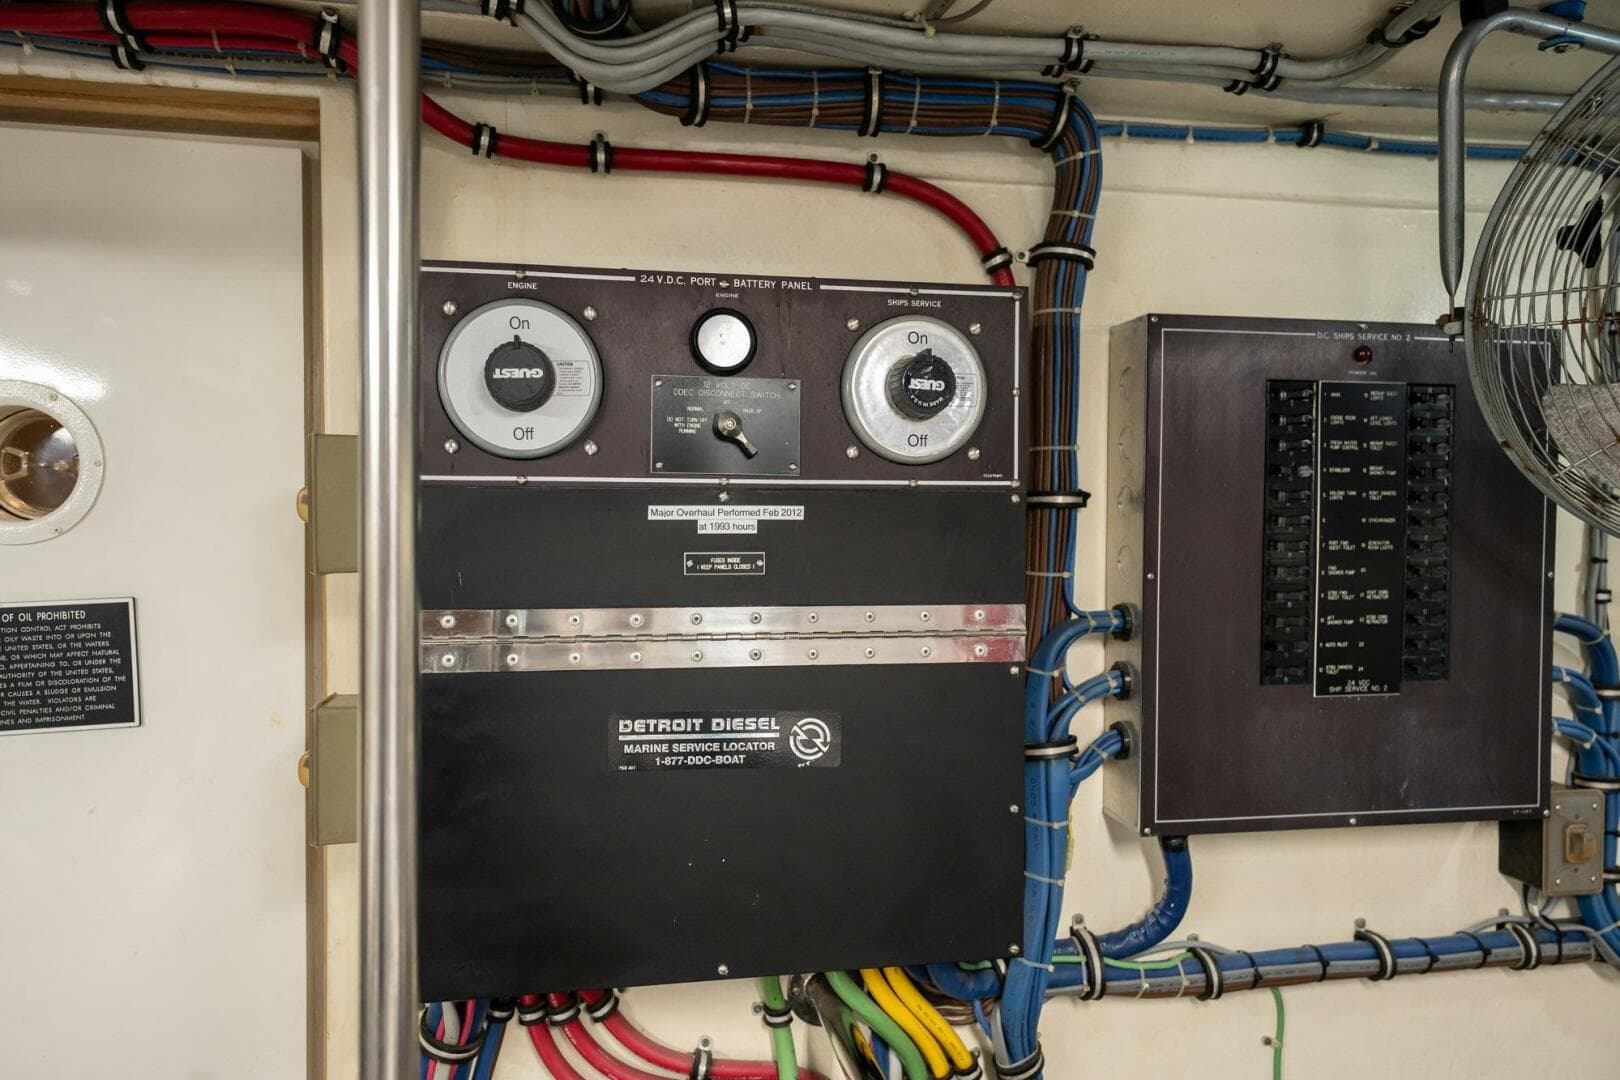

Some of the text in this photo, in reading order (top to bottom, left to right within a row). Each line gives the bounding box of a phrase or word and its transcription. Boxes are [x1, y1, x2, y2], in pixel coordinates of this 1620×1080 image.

[507, 281, 538, 290] ENGINE
[640, 274, 812, 290] 24 V.D.C. PORT BATTERY PANEL
[888, 299, 942, 308] SHIPS SERVICE
[509, 316, 530, 330] On
[908, 331, 928, 344] On
[1333, 332, 1354, 340] SHIPS
[1358, 333, 1388, 341] SERVICE
[492, 368, 543, 378] GUEST
[908, 378, 945, 392] GUEST
[698, 389, 746, 398] DISCONNECT
[750, 391, 781, 400] SWITCH
[512, 426, 534, 440] Off
[908, 434, 928, 448] Off
[650, 508, 802, 518] Major Overhaul Performed Feb 2012
[698, 522, 756, 532] at 1993 hours
[1, 610, 86, 622] OF OIL PROHIBITED
[48, 677, 100, 686] DISCOLORATION
[84, 685, 116, 693] EMULSION
[618, 717, 780, 733] DETROIT DIESEL
[624, 742, 776, 754] MARINE SERVICE LOCATOR
[655, 754, 746, 766] 1-877-DDC-BOAT
